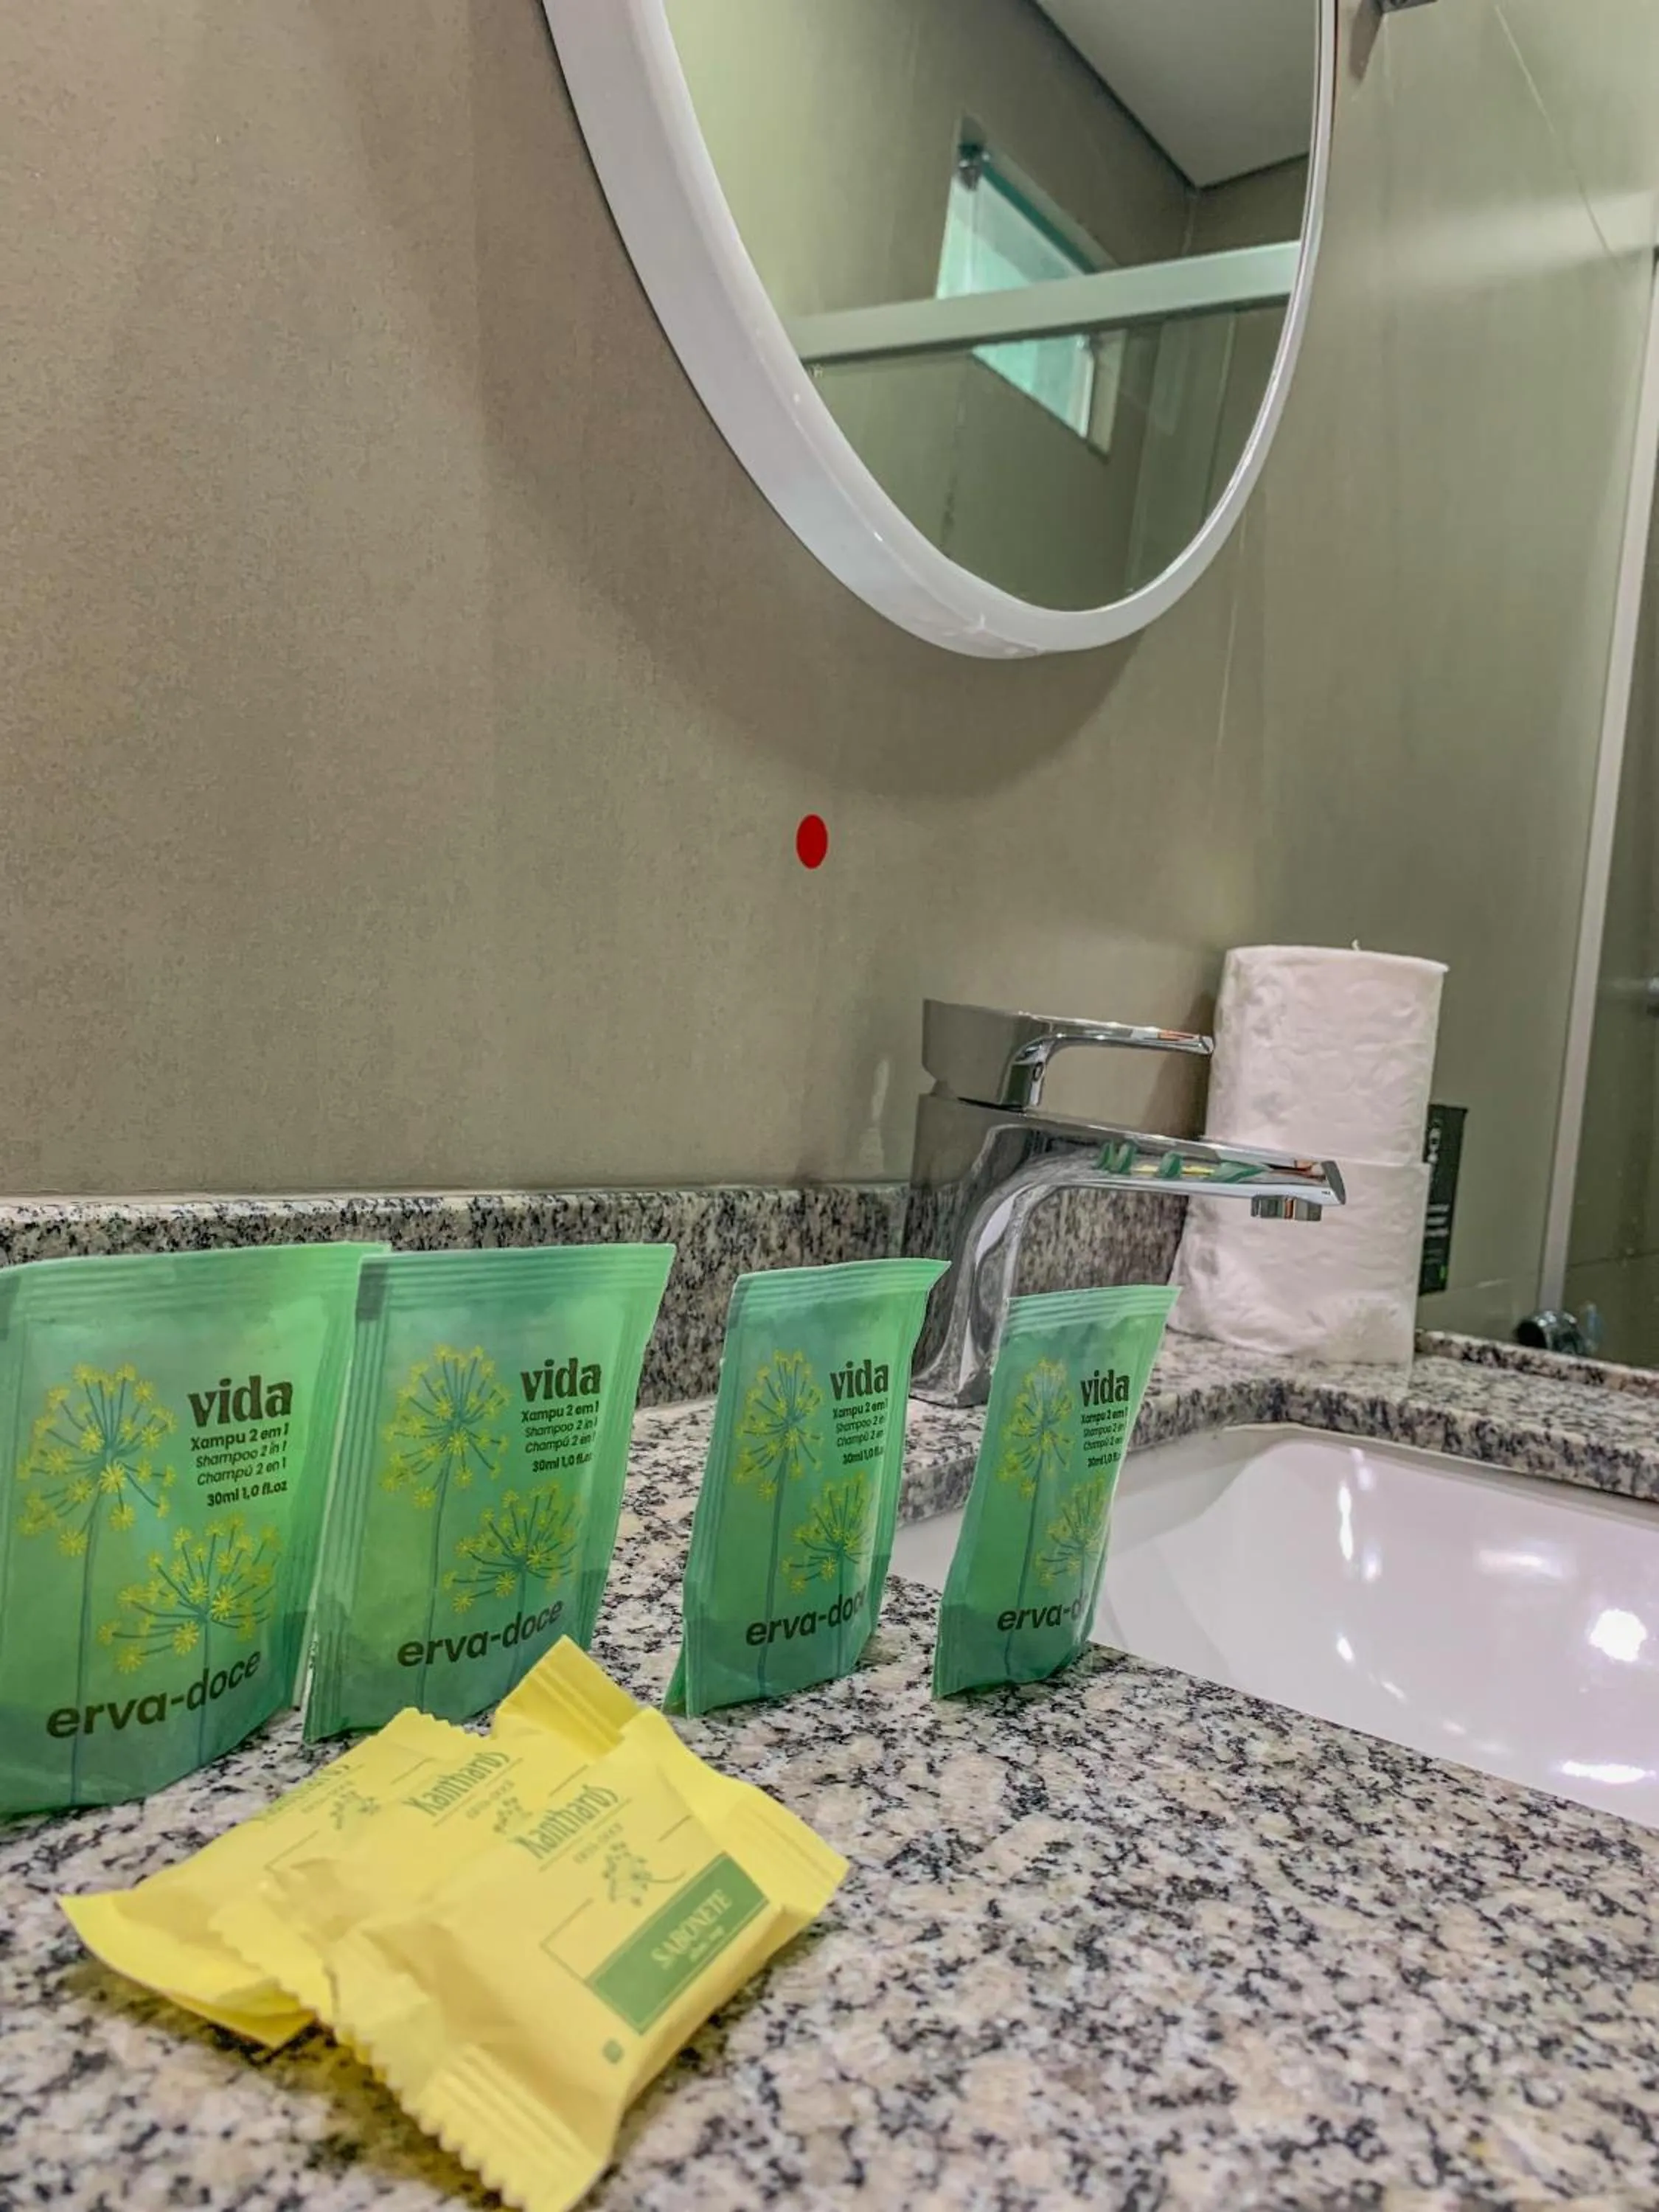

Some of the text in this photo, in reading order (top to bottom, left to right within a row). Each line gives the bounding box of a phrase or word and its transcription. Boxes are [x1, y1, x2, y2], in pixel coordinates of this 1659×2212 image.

[521, 1357, 602, 1402] vida
[830, 1359, 888, 1400] vida
[1080, 1369, 1130, 1407] vida
[187, 1374, 293, 1427] vida
[521, 1407, 564, 1422] Xampu
[566, 1404, 573, 1416] 2
[575, 1404, 594, 1415] em
[832, 1405, 863, 1419] Xampu
[865, 1402, 871, 1413] 2
[191, 1422, 289, 1451] Xampu 2 em 1
[525, 1423, 574, 1438] Shampoo
[577, 1420, 582, 1430] 2
[571, 1435, 578, 1445] 2
[196, 1450, 258, 1468] Shampoo
[260, 1445, 268, 1456] 2
[270, 1441, 279, 1455] in
[532, 1457, 559, 1472] 30ml
[197, 1465, 253, 1486] Champú
[257, 1463, 263, 1475] 2
[266, 1461, 279, 1472] en
[207, 1488, 239, 1507] 30ml
[397, 1600, 563, 1666] erva-doce
[46, 1650, 261, 1739] erva-doce
[652, 1888, 733, 1970] SABONETE
